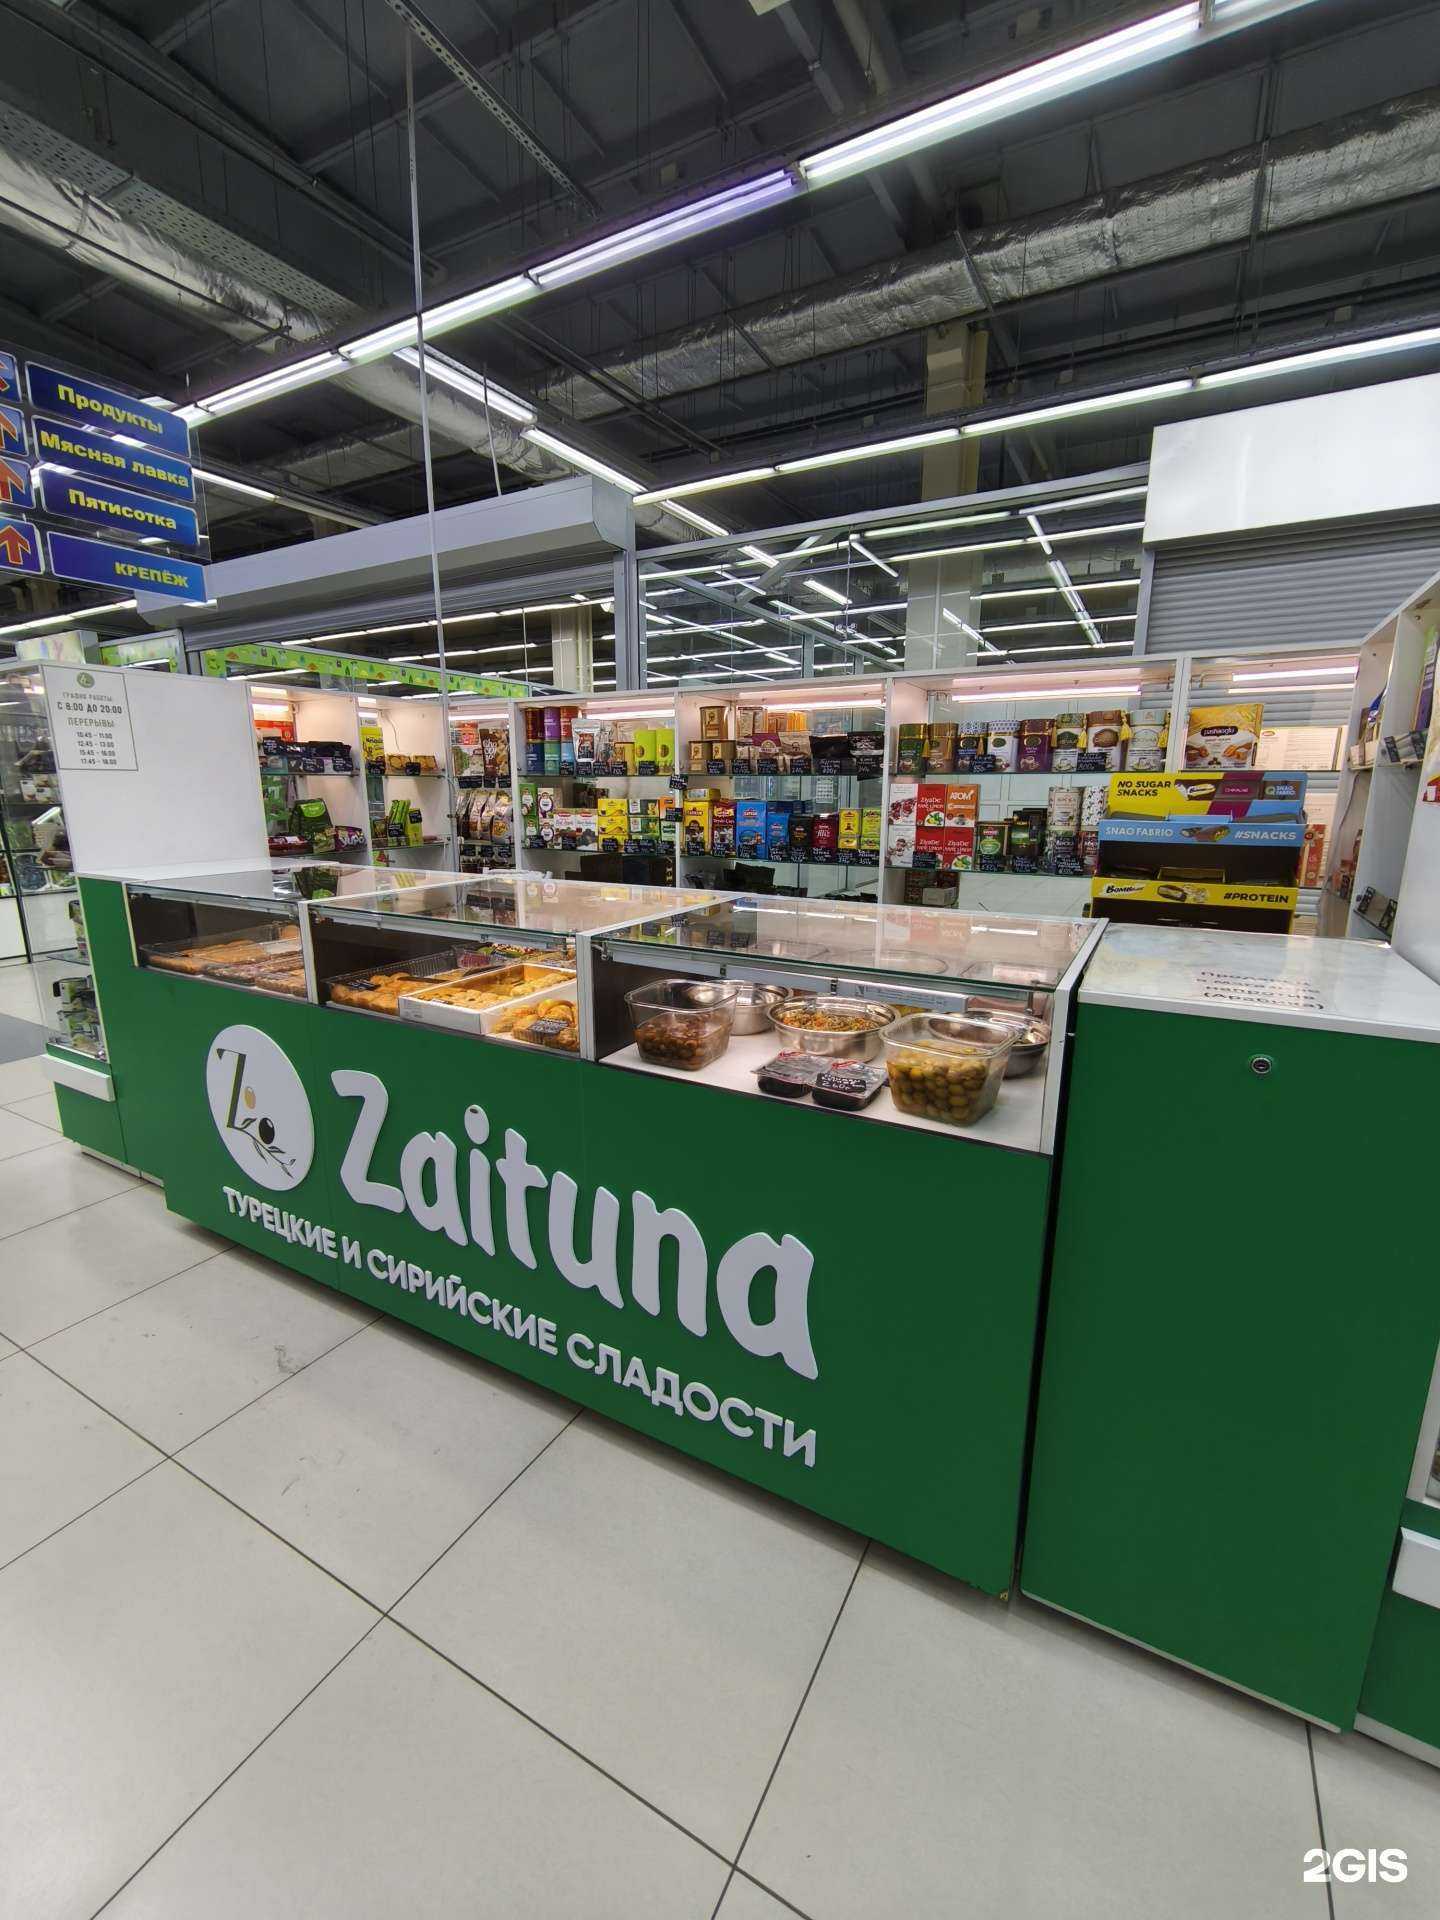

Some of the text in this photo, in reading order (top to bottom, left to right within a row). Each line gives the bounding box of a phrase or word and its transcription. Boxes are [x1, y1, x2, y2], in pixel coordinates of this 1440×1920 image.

[57, 384, 164, 434] Продукты
[40, 431, 189, 488] Мясная лавка
[68, 488, 177, 530] Пятисотка
[115, 561, 189, 588] КРЕПЁЖ
[57, 701, 63, 710] С
[87, 703, 98, 713] ДО
[67, 717, 115, 728] ПЕРЕРЫВЫ
[1117, 780, 1172, 789] NO SUGAR
[1117, 788, 1158, 797] SNACKS
[1234, 830, 1296, 841] #SNACKS
[1223, 892, 1289, 904] #PROTEIN
[330, 1069, 819, 1380] Zaituna
[222, 1186, 817, 1468] ТУРЕЦКИЕ И СИРИЙСКИЕ СЛАДОСТИ
